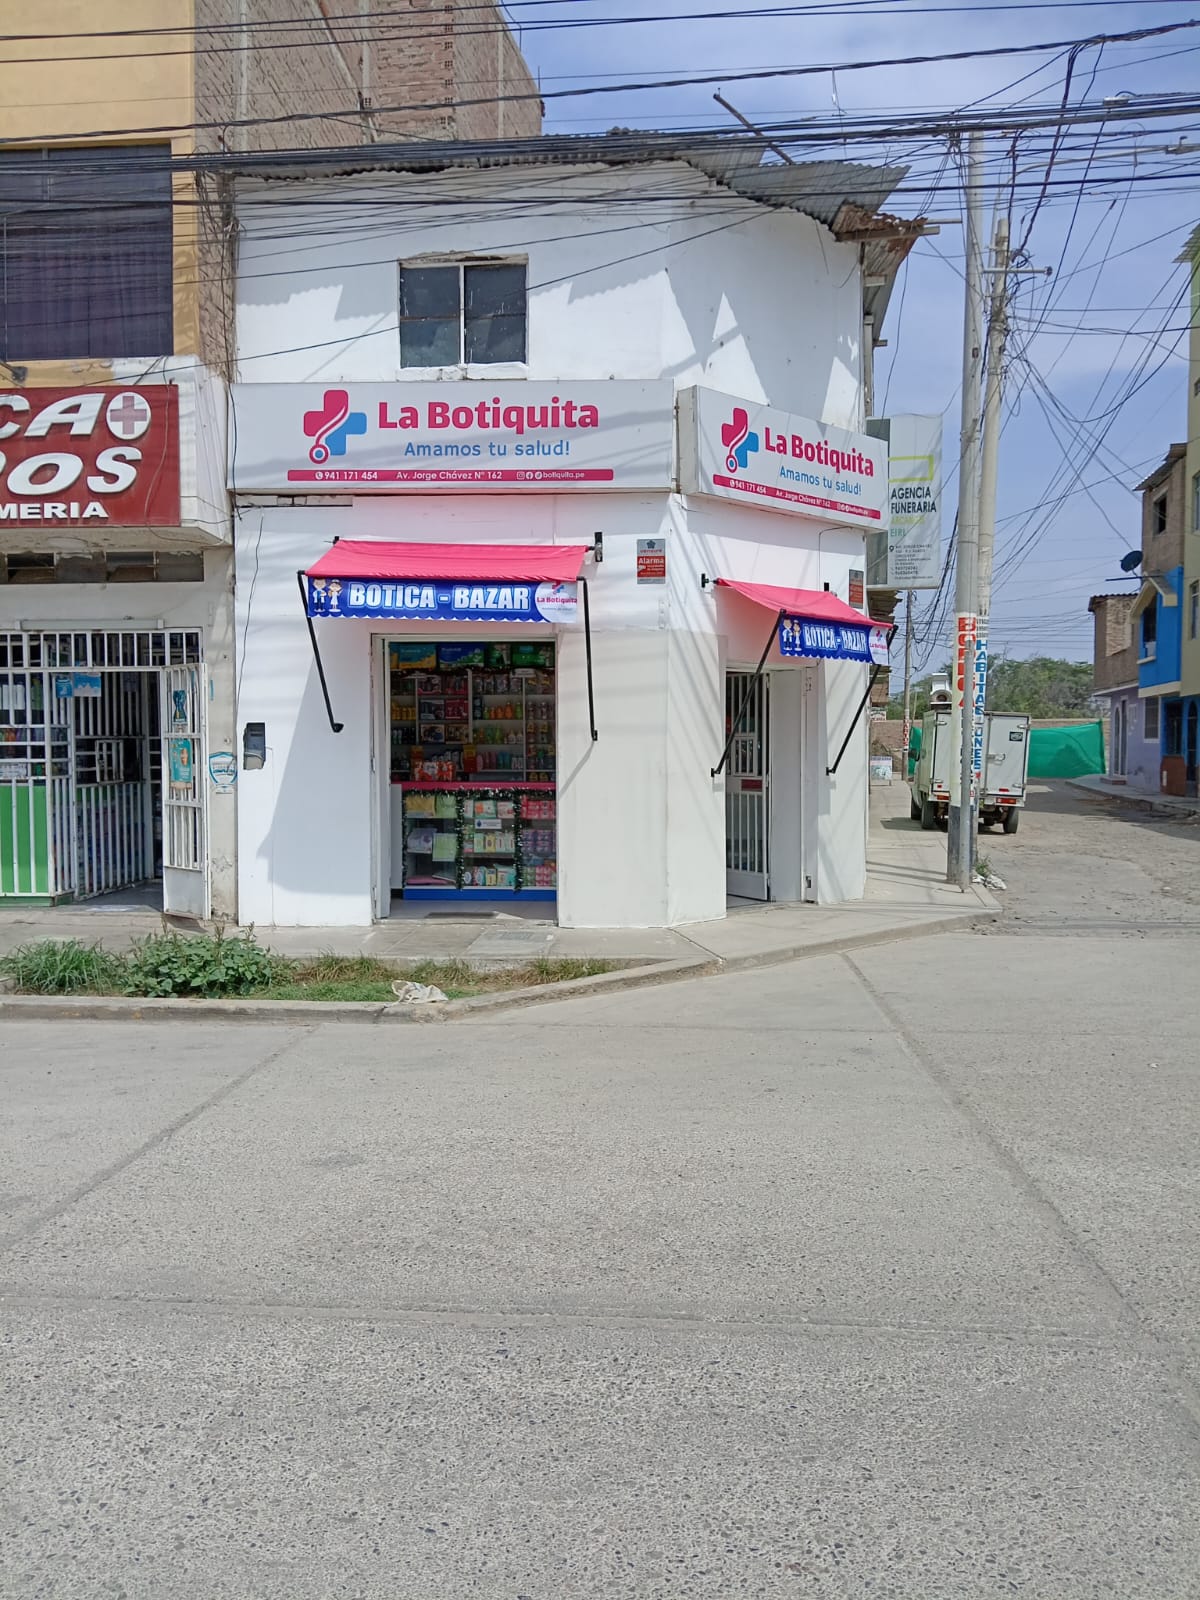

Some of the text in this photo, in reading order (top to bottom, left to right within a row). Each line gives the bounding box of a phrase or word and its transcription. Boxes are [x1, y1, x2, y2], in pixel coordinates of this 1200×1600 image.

[379, 396, 599, 435] La Botiquita
[404, 440, 570, 457] Amamos tu salud!
[764, 427, 874, 477] La Botiquita
[0, 446, 142, 495] OS
[324, 471, 378, 480] 941 171 454
[396, 471, 410, 480] Av.
[412, 471, 437, 481] Jorge
[439, 470, 472, 480] Chávez
[487, 471, 502, 480] 162
[542, 471, 585, 481] botiquita.pe
[780, 465, 862, 496] Amamos tu salud!
[891, 486, 931, 499] AGENCIA
[891, 501, 937, 514] FUNERARIA
[349, 583, 436, 609] BOTICA
[453, 587, 529, 610] BAZAR
[804, 625, 836, 649] BOTICA
[841, 630, 866, 652] BAZAR
